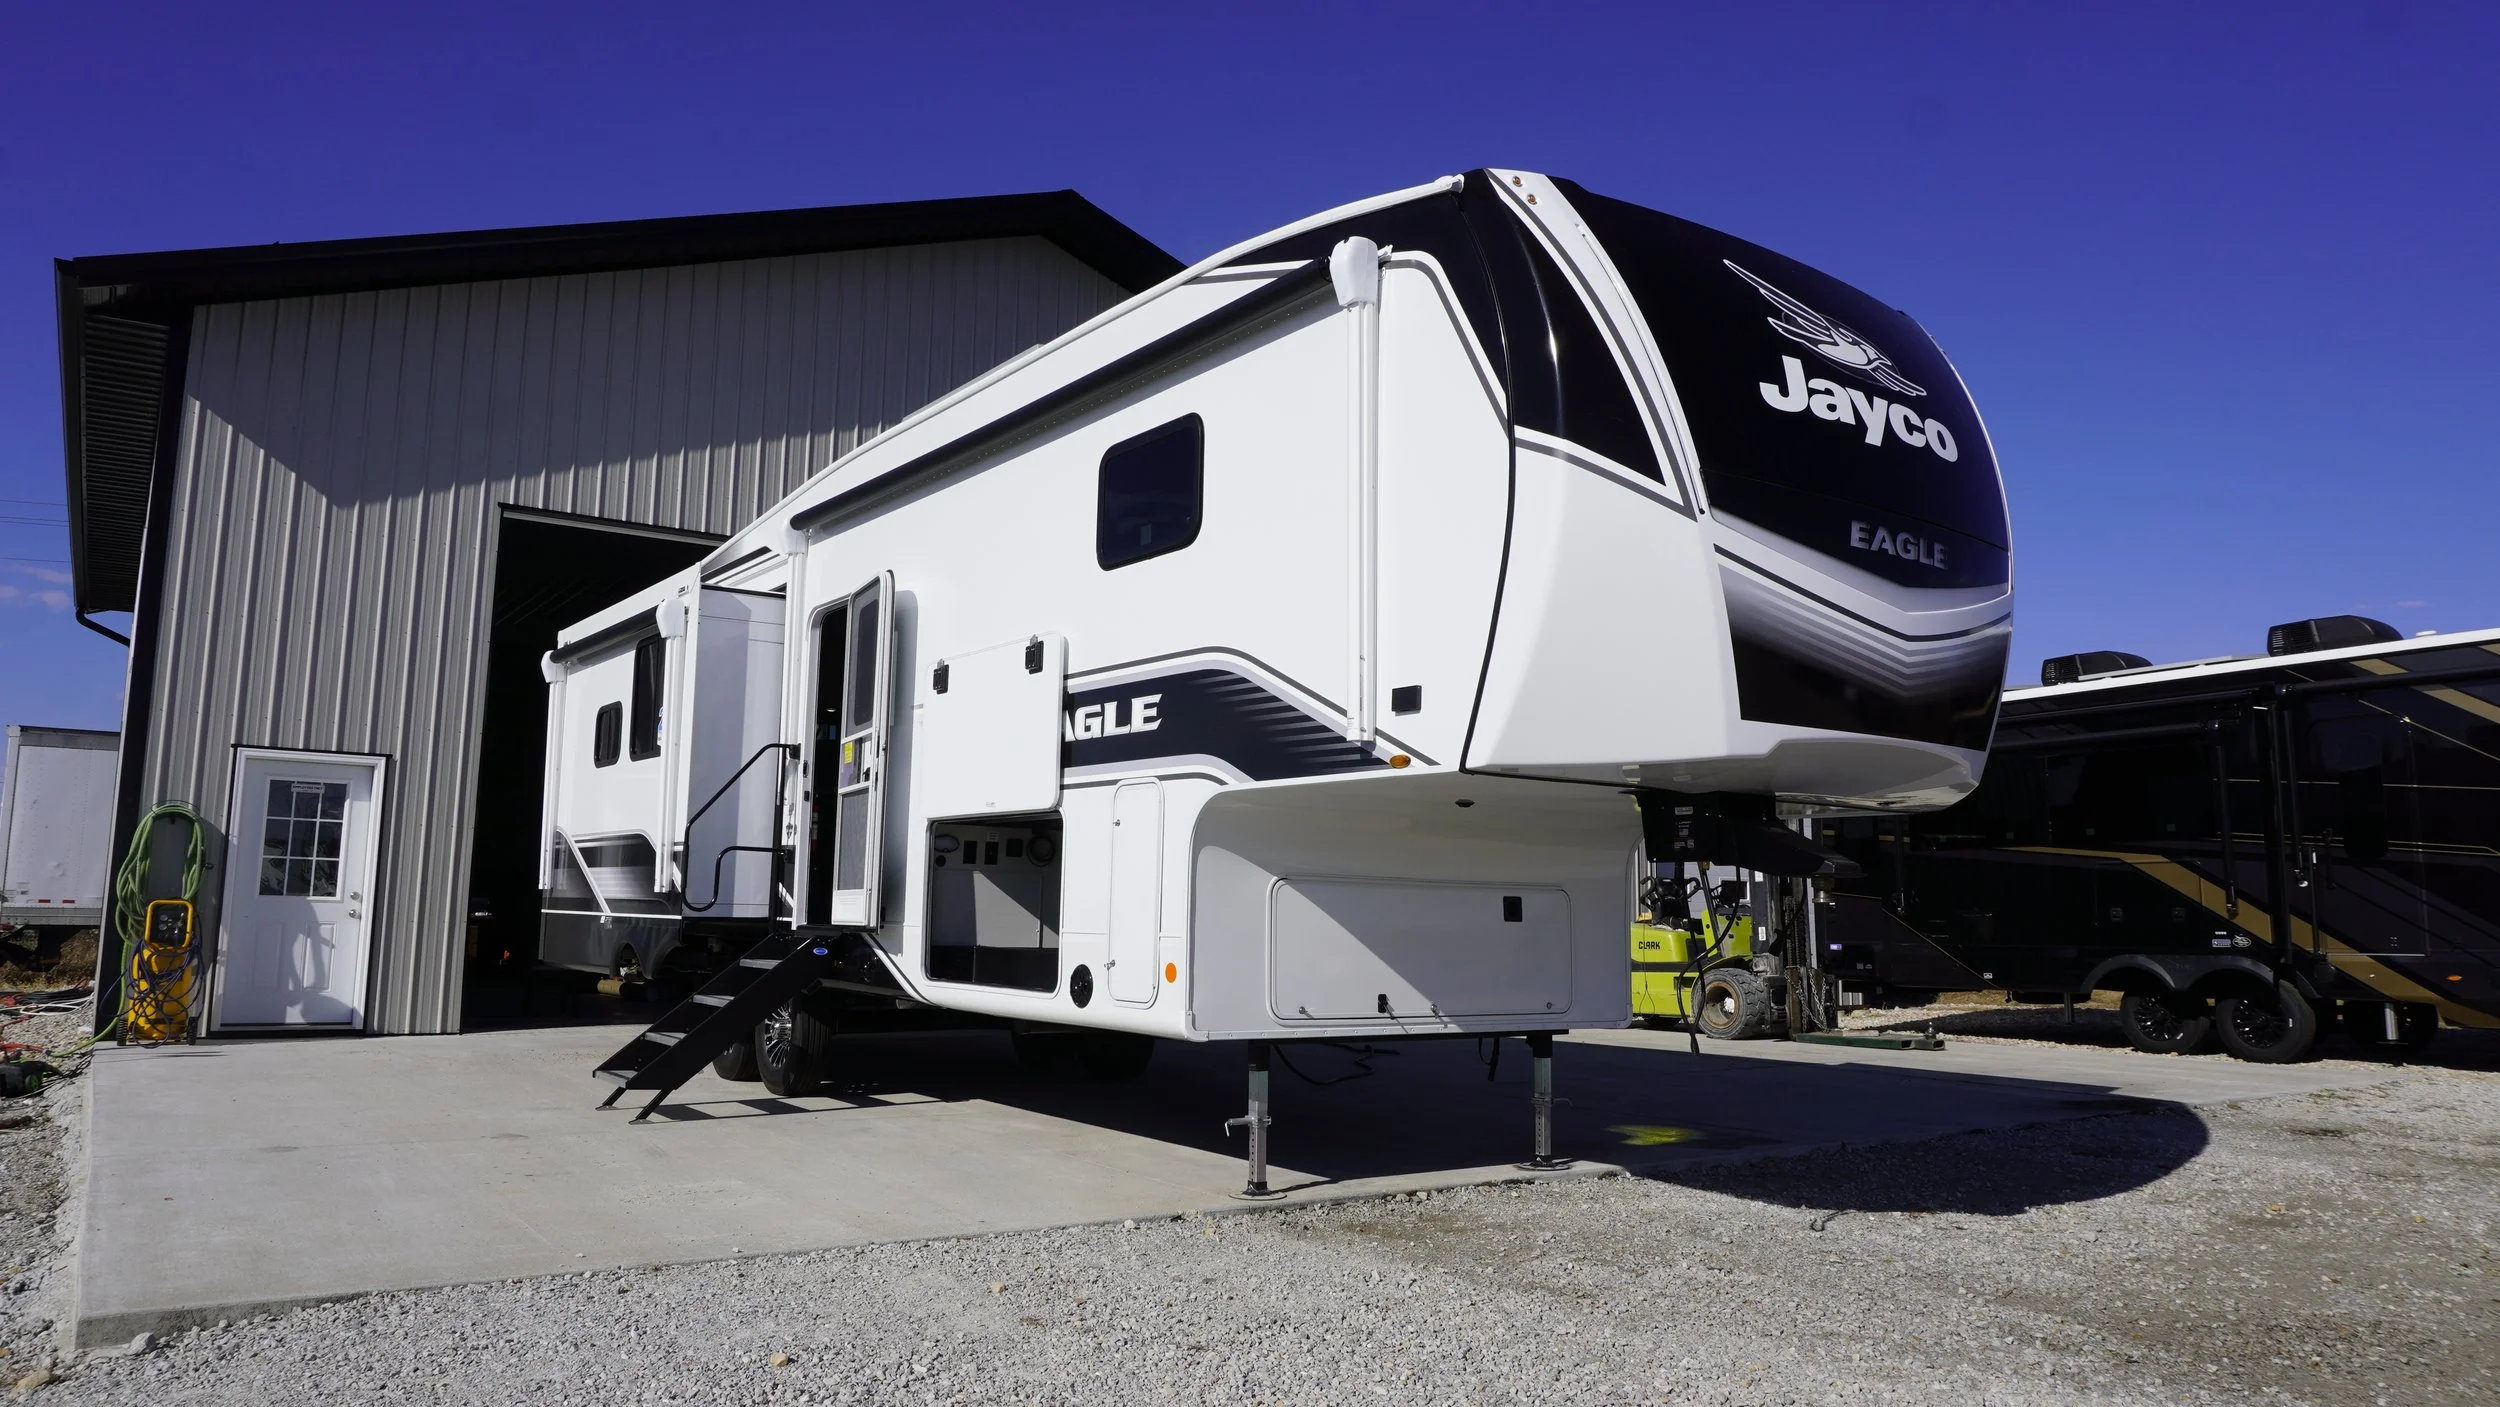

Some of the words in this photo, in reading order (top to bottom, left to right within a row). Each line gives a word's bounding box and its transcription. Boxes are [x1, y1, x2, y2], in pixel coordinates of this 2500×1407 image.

[1759, 355, 1958, 462] Jayco
[1850, 520, 1948, 569] EAGLE
[1638, 941, 1661, 950] CLARK
